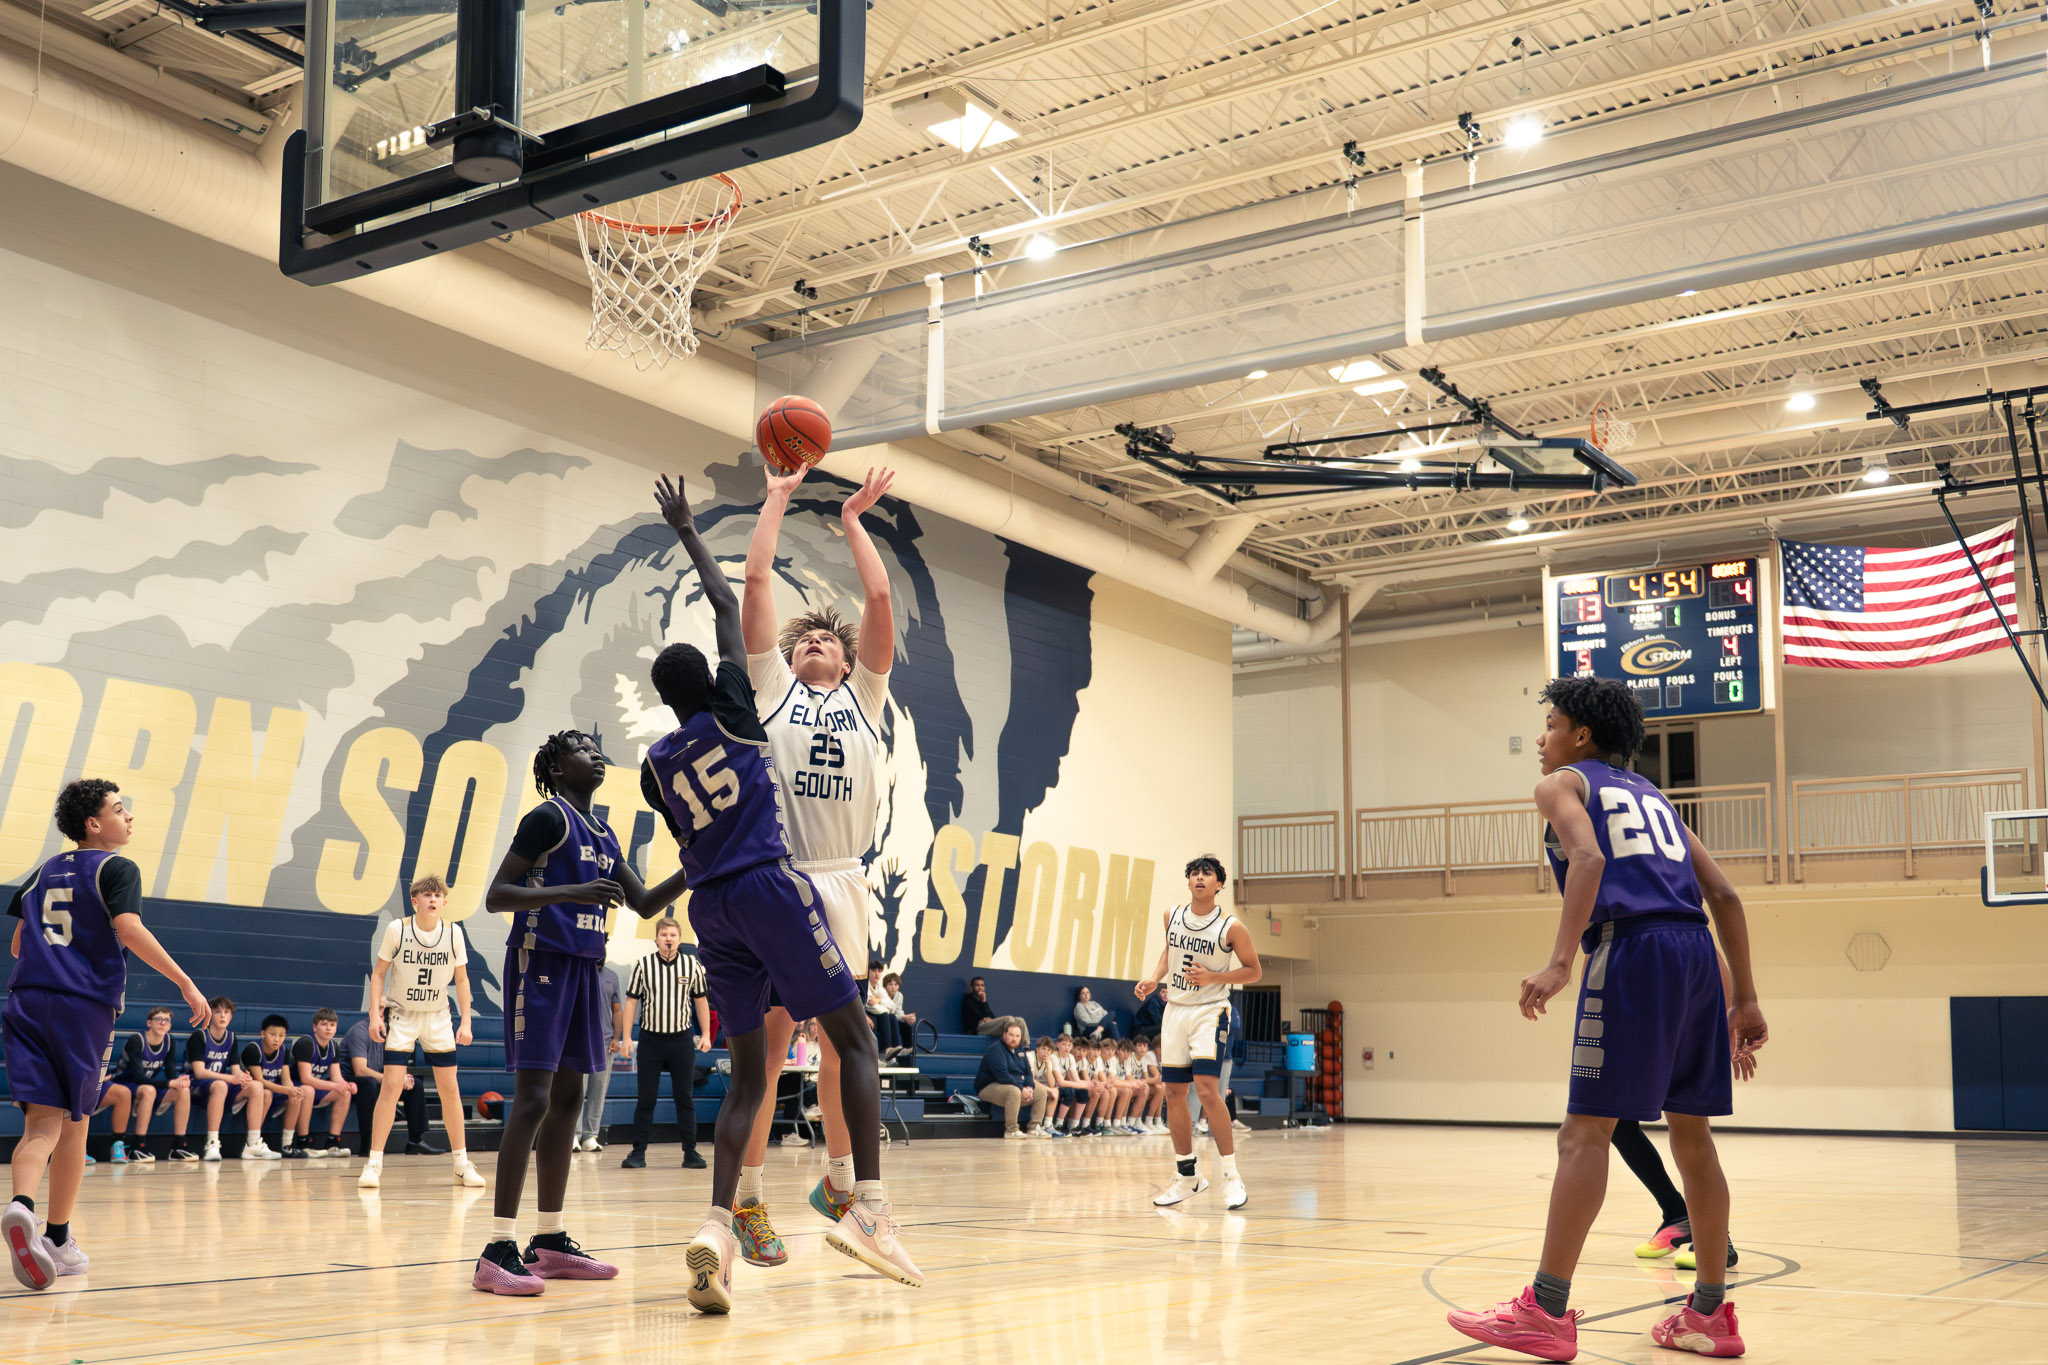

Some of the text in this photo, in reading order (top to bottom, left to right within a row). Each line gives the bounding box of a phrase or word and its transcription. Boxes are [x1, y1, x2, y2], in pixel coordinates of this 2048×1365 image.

[1628, 569, 1697, 600] 4:54
[1734, 578, 1752, 604] 4
[1578, 596, 1602, 621] 13
[1629, 611, 1663, 624] PERIOD
[1674, 605, 1681, 626] 1
[1705, 610, 1736, 622] BONUS
[1576, 623, 1606, 635] BONUS
[1706, 624, 1753, 637] TIMEOUTS
[1562, 638, 1606, 652] TIMEOUTS
[1651, 649, 1692, 662] STORM
[1723, 634, 1739, 656] 4
[1577, 649, 1592, 671] 5
[1720, 656, 1743, 667] LEFT
[1627, 674, 1695, 689] PLAYER FOULS
[1714, 670, 1743, 681] FOULS
[1728, 680, 1743, 702] 0
[672, 744, 740, 831] 15
[794, 770, 852, 802] SOUTH
[1599, 786, 1687, 862] 20
[920, 824, 1155, 981] STORM
[43, 888, 74, 947] 5
[1169, 932, 1216, 956] ELKHORN
[403, 949, 449, 966] ELKHORN
[417, 968, 432, 986] 21
[406, 988, 440, 1001] SOUTH
